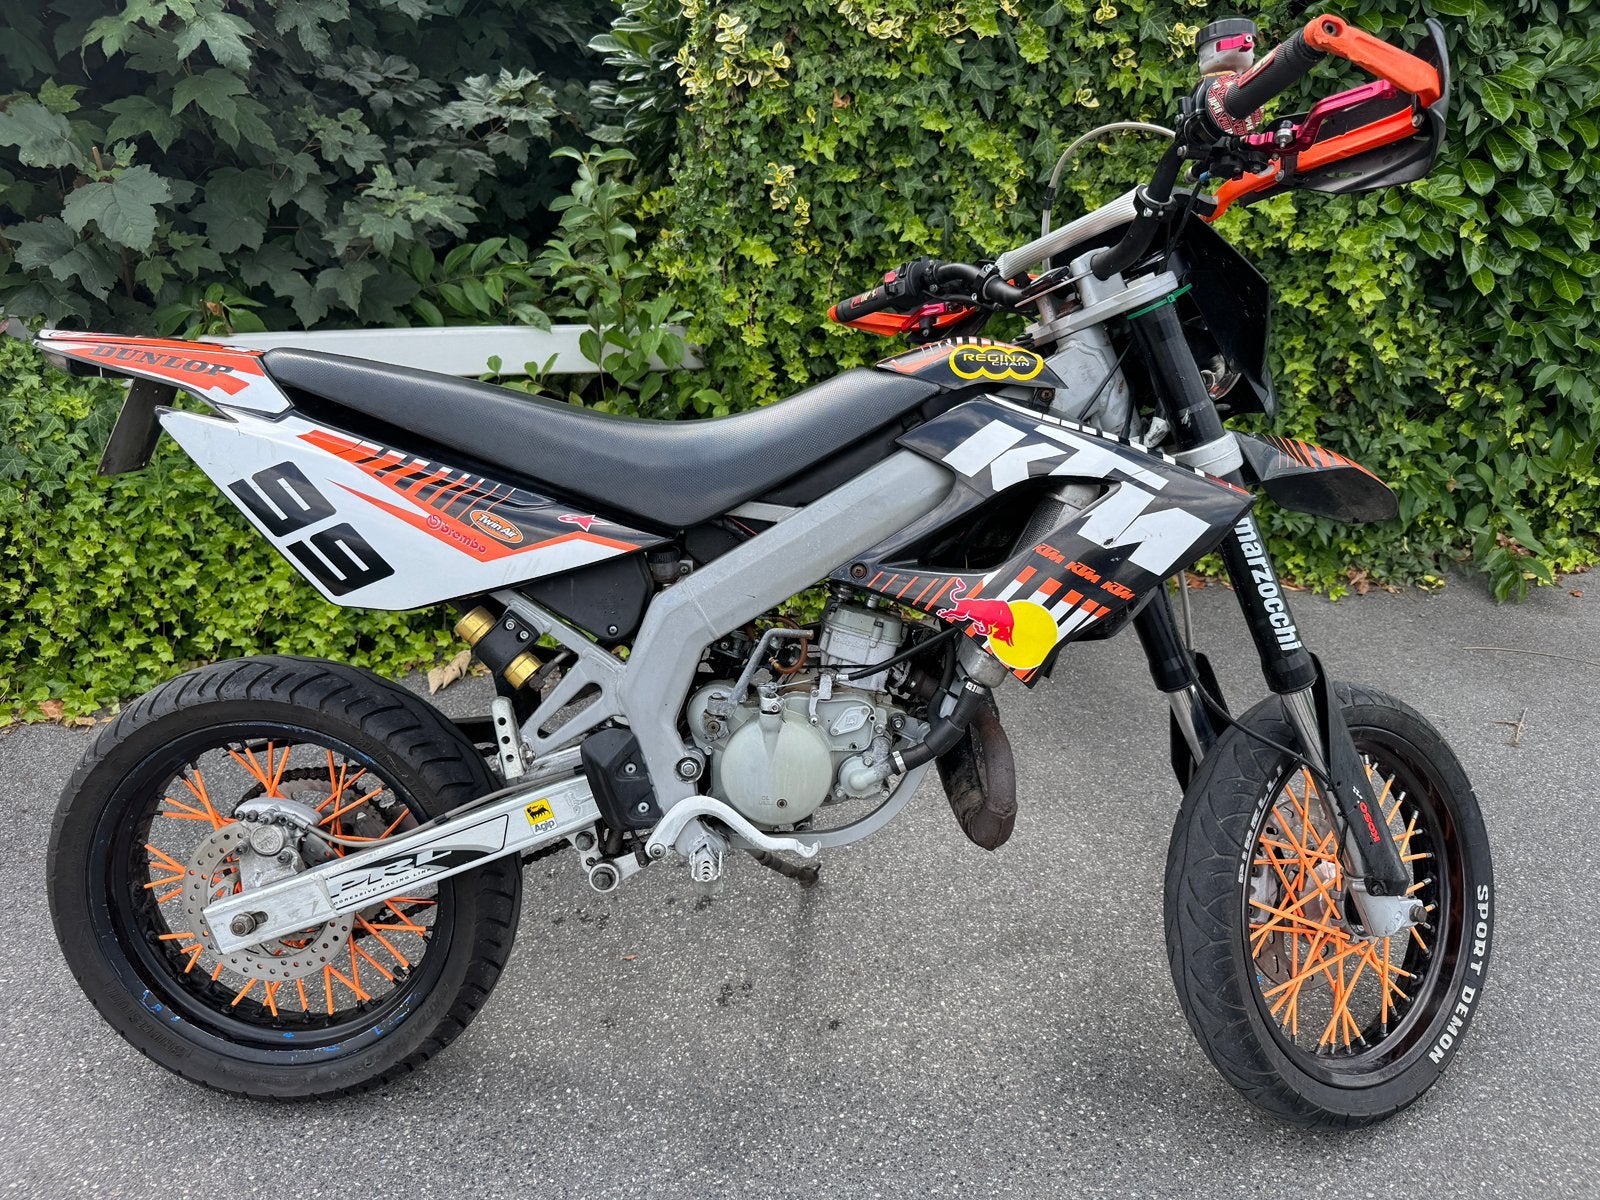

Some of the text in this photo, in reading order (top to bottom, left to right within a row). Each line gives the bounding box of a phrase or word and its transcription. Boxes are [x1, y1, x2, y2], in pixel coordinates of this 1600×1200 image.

[89, 344, 235, 377] DUNLOP
[963, 352, 1029, 364] REGINA
[942, 419, 1211, 576] KTM
[227, 461, 395, 596] 99
[441, 523, 486, 553] brembo
[478, 513, 519, 539] Twin Air
[1032, 542, 1136, 601] KTM KTM KTM
[1234, 516, 1303, 651] marzocchi
[533, 819, 556, 834] Agip
[1237, 764, 1284, 884] PIRELLI
[1359, 801, 1381, 843] KOSO
[380, 876, 411, 889] RACING
[413, 867, 432, 877] LINK
[1428, 884, 1490, 1065] SPORT DEMON
